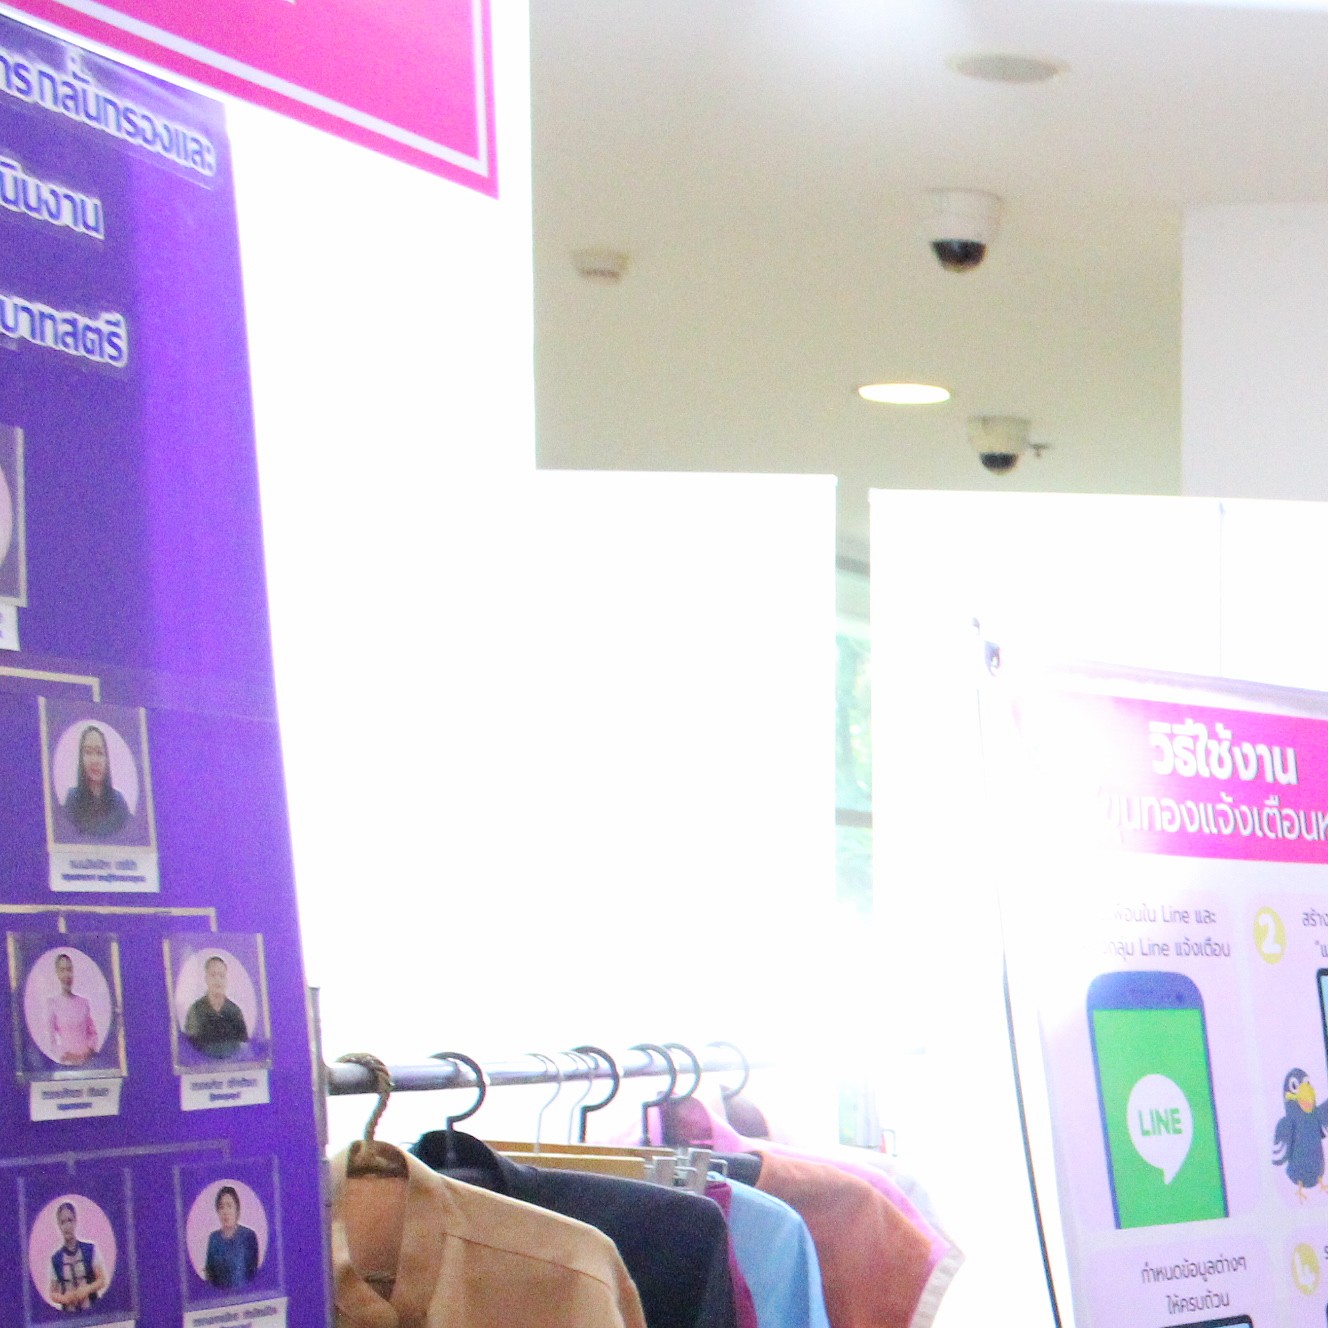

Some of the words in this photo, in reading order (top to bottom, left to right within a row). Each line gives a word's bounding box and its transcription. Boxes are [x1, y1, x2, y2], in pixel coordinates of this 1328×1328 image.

[1148, 719, 1299, 785] วิธีใช้งาน
[1161, 904, 1190, 925] Line
[1195, 908, 1217, 925] และ
[1139, 938, 1170, 957] Line
[1175, 936, 1231, 957] แจ้งเตือน
[1259, 913, 1282, 954] 2
[1138, 1107, 1183, 1136] LINE
